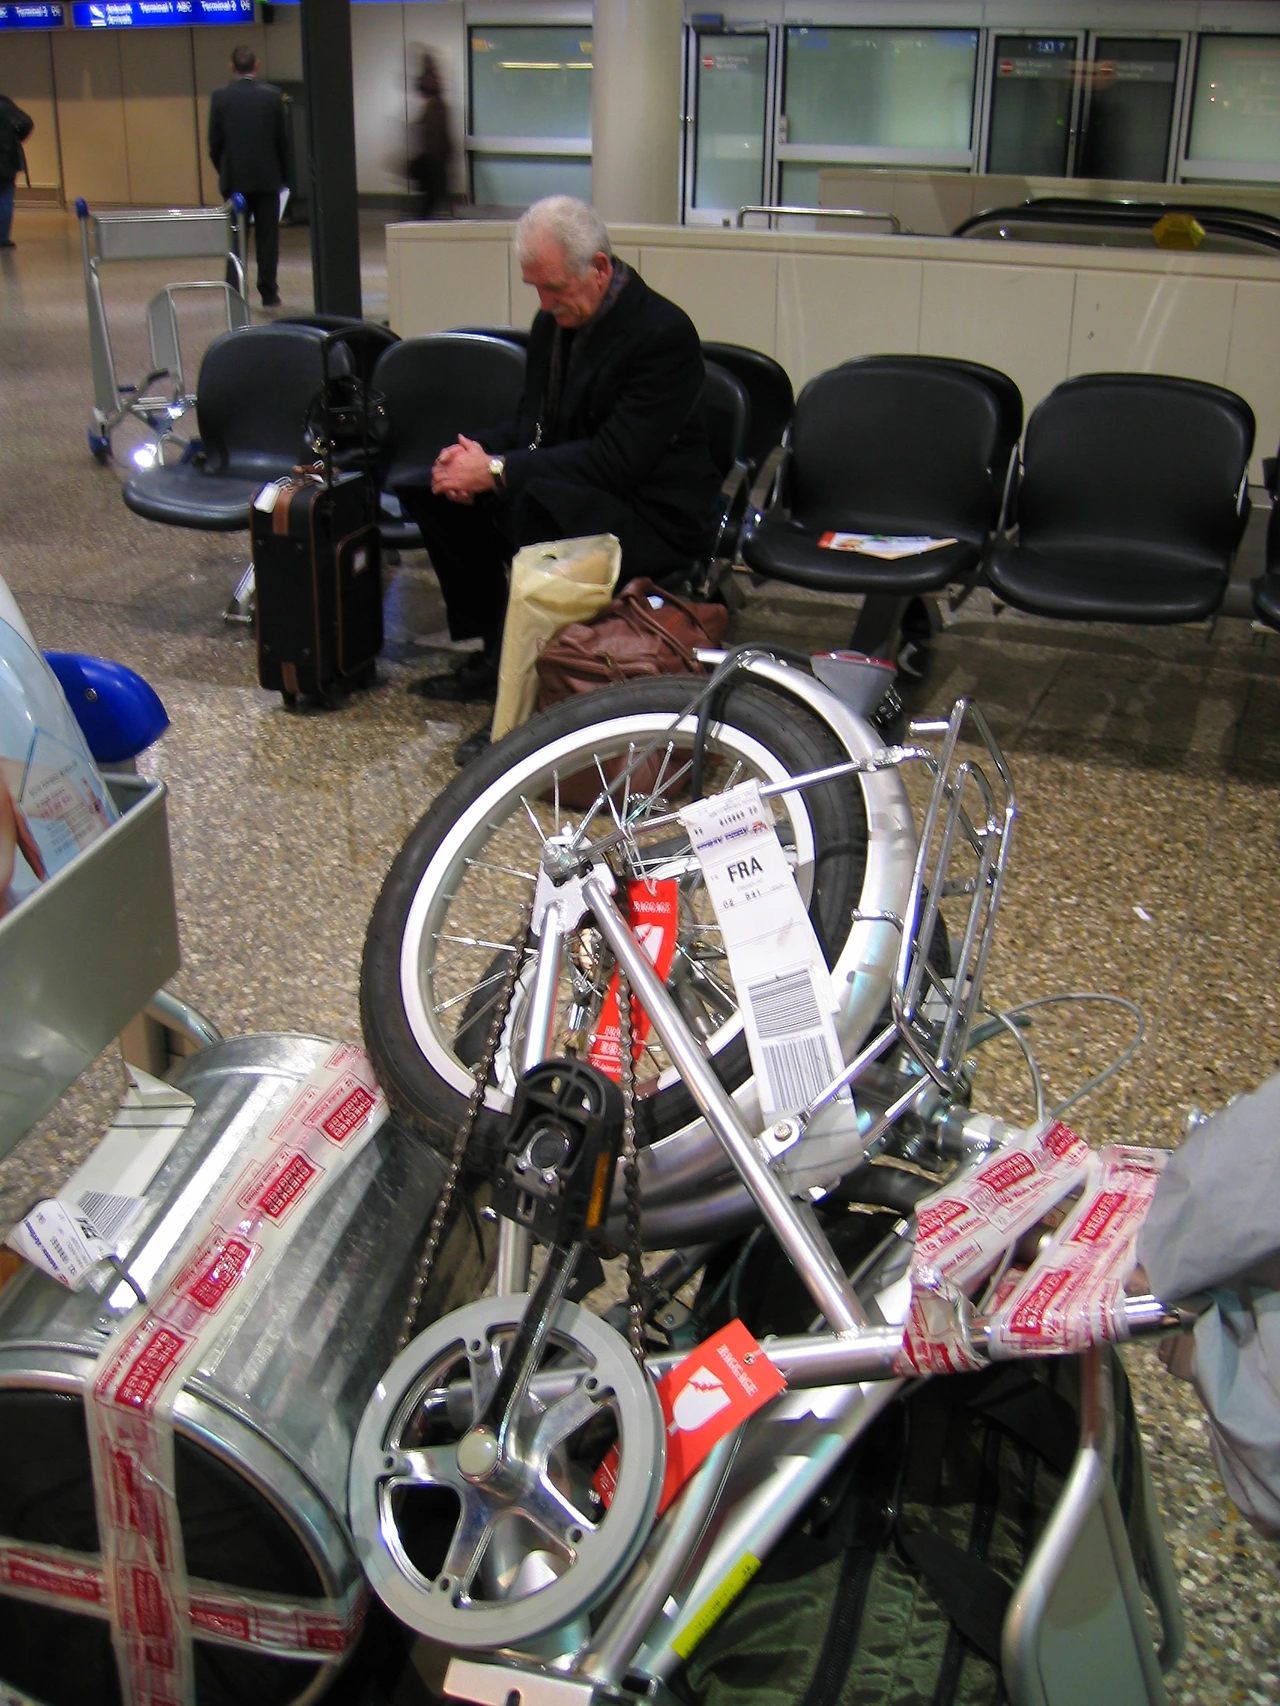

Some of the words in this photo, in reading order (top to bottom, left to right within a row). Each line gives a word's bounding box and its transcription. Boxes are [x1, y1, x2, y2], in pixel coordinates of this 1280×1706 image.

[15, 7, 42, 17] Terminal
[139, 2, 170, 13] Terminal
[176, 1, 192, 13] ABC
[201, 1, 229, 12] Terminal
[725, 854, 763, 883] FRA
[633, 900, 670, 913] BAGGAGE
[325, 1090, 364, 1131] BAGGAGE
[332, 1096, 371, 1137] CHECKED
[260, 1157, 303, 1206] BAGGAGE
[981, 1152, 1025, 1183] CHECKED
[268, 1165, 310, 1214] CHECKED
[118, 1330, 169, 1400] BAGGAGE
[715, 1343, 759, 1397] BAGGAGE
